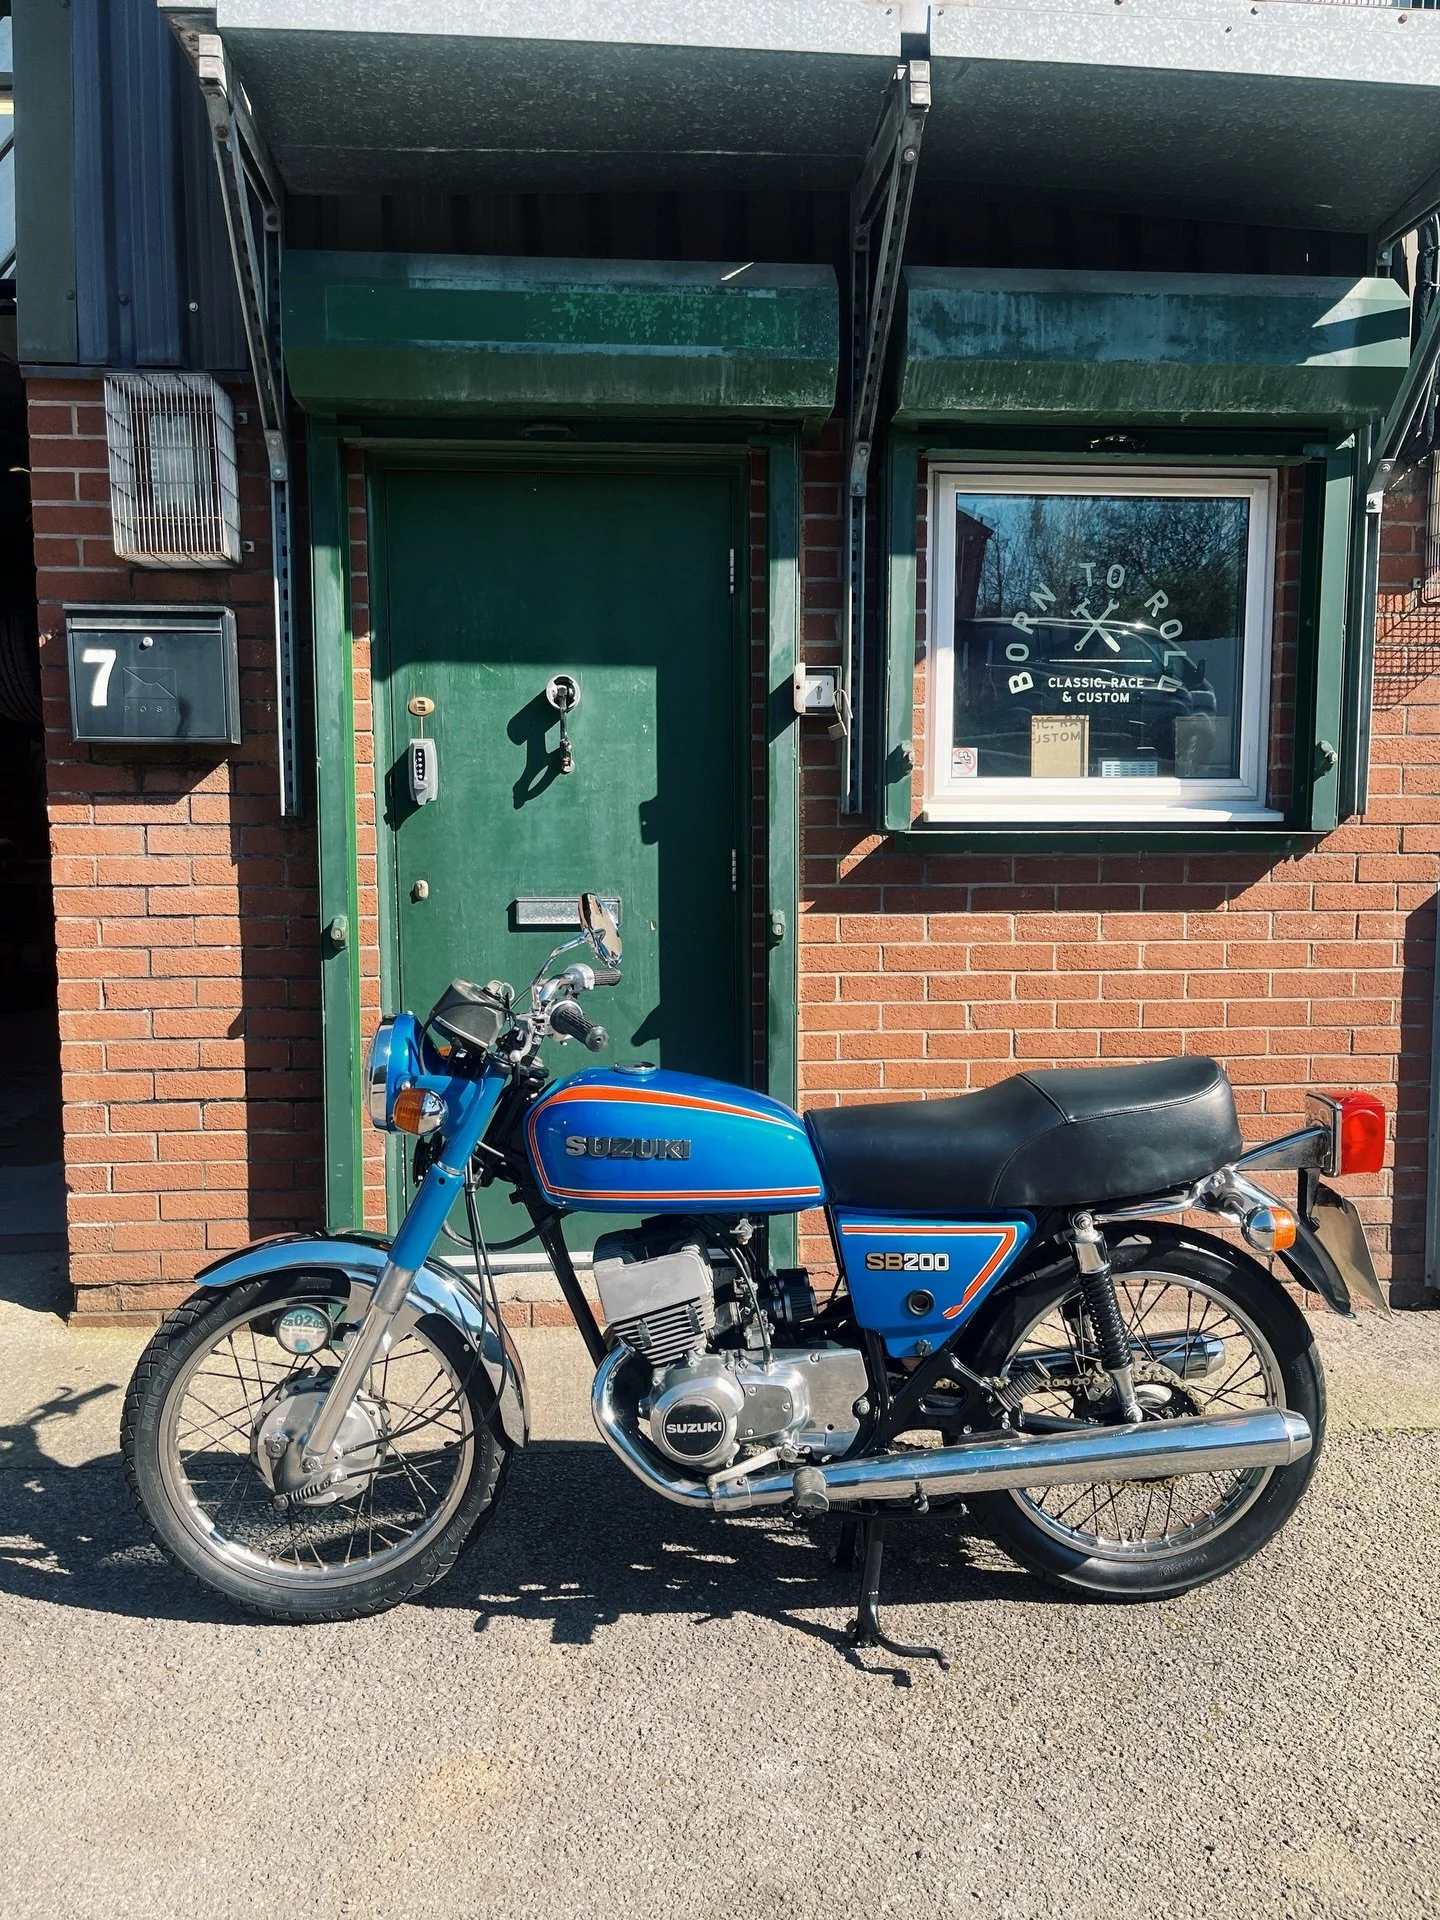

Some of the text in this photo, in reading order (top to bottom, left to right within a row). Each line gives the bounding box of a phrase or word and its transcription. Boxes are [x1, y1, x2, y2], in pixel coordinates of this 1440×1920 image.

[1005, 562, 1187, 694] BORN TO ROLL
[82, 648, 117, 707] 7
[1047, 677, 1145, 690] CLASSIC, RACE
[1062, 691, 1130, 703] & CUSTOM
[124, 705, 177, 713] POST
[565, 1135, 691, 1159] SUZUKI
[866, 1252, 949, 1271] SB200
[295, 1314, 312, 1327] 02
[666, 1421, 722, 1434] SUZUKI
